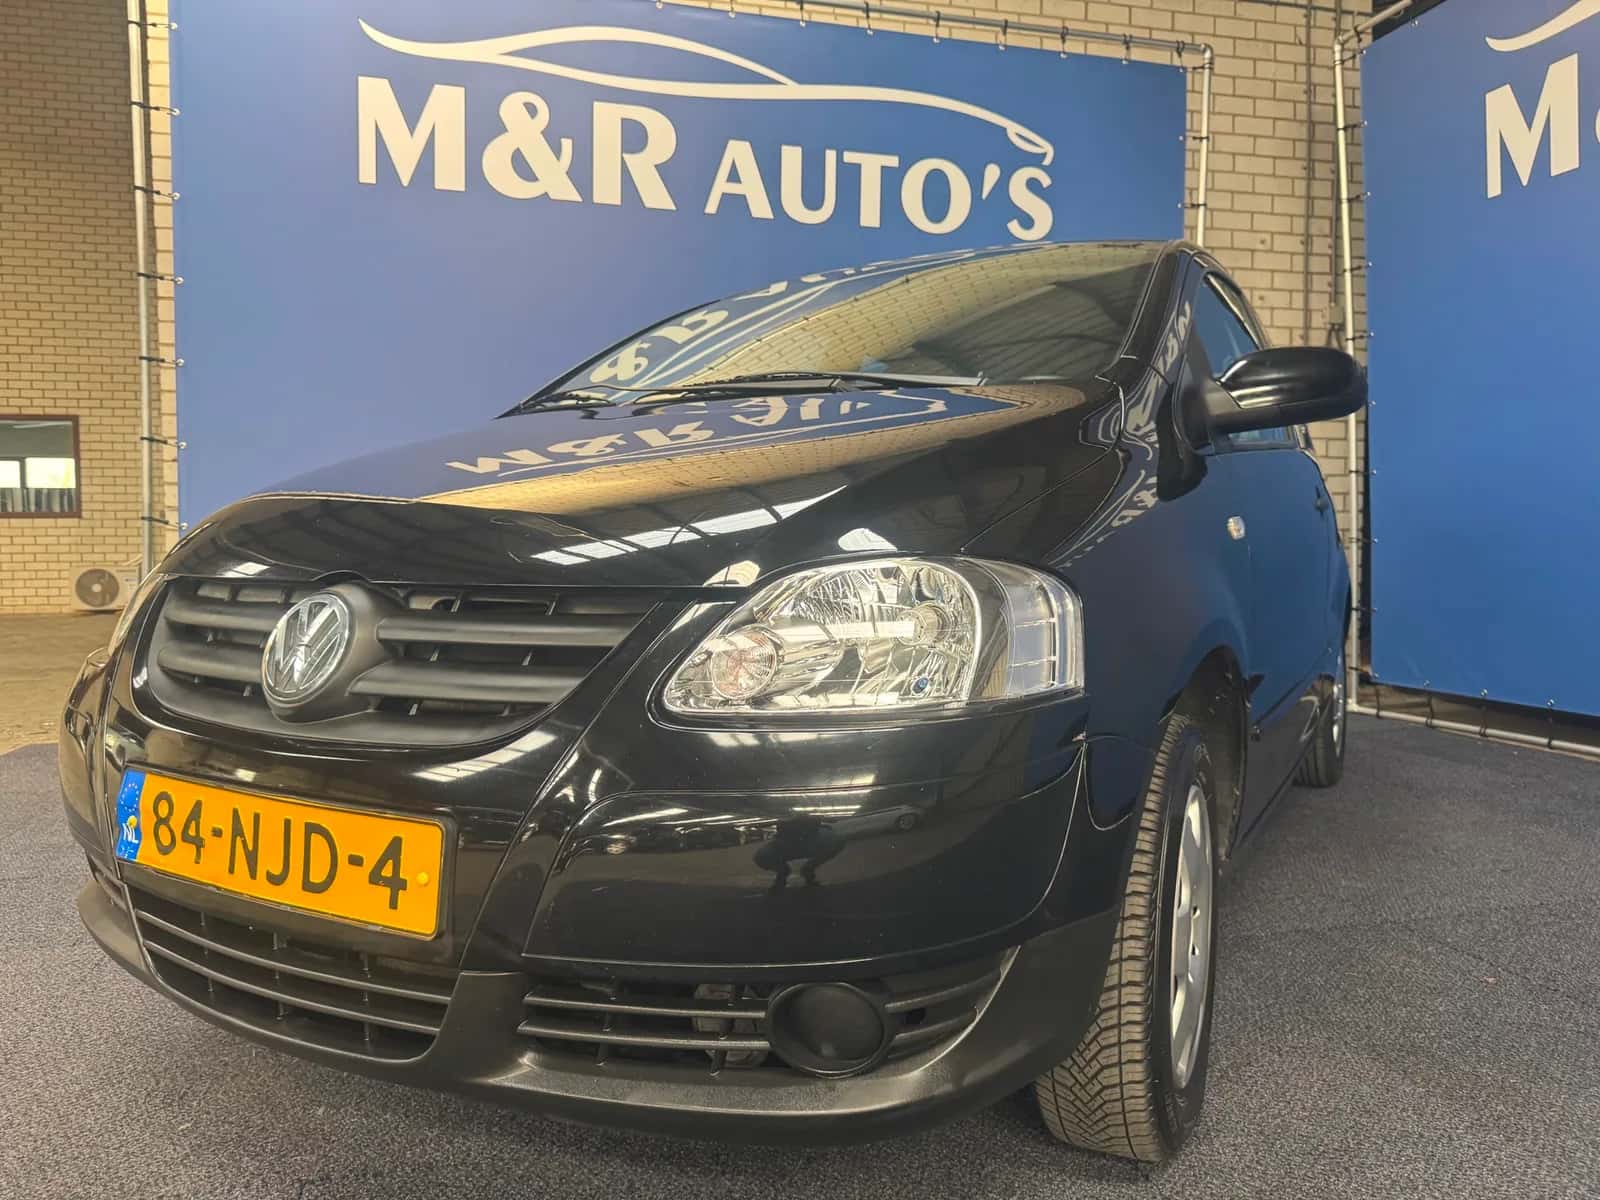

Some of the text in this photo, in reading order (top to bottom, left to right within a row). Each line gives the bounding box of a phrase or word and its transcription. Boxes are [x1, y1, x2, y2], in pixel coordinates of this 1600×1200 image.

[357, 75, 1054, 241] M&R AUTO'S
[1485, 52, 1600, 199] M
[152, 791, 408, 910] 84-NJD-4
